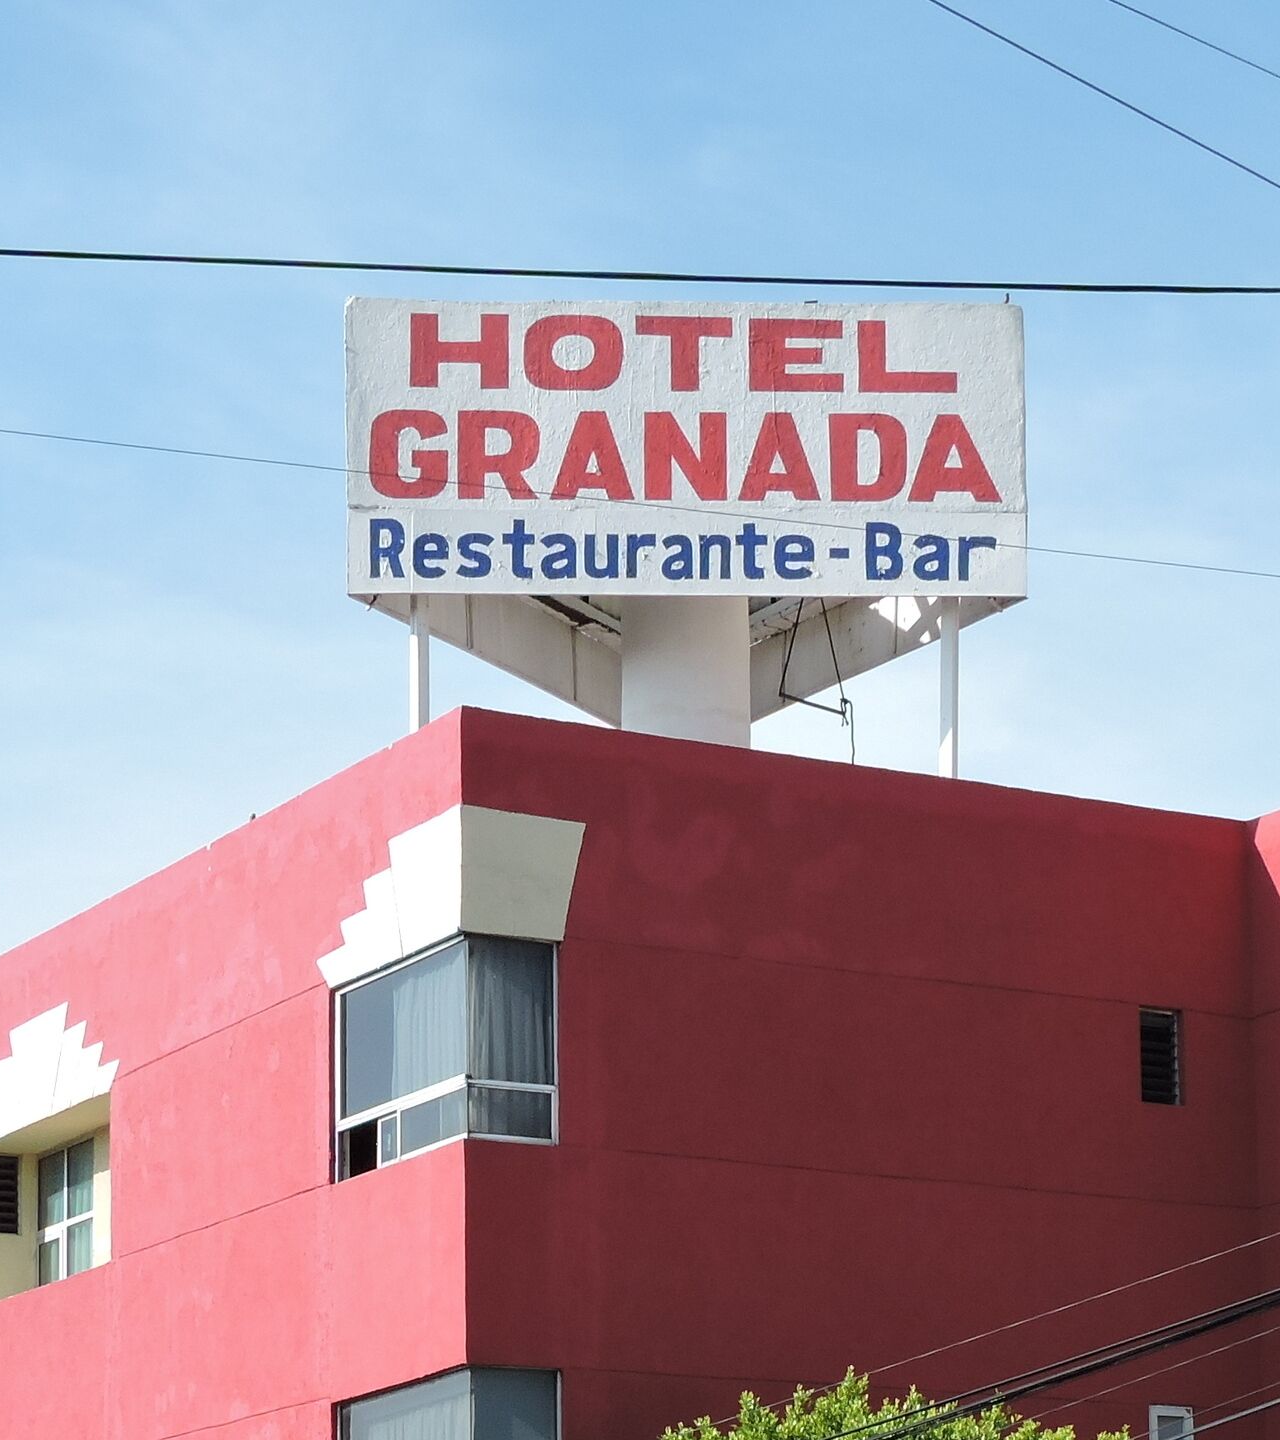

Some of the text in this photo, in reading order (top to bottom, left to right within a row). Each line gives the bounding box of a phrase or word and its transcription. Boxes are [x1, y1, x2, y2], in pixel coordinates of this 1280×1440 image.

[409, 313, 958, 393] HOTEL
[368, 409, 1002, 503] GRANADA
[368, 518, 997, 582] Restaurante-Bar
